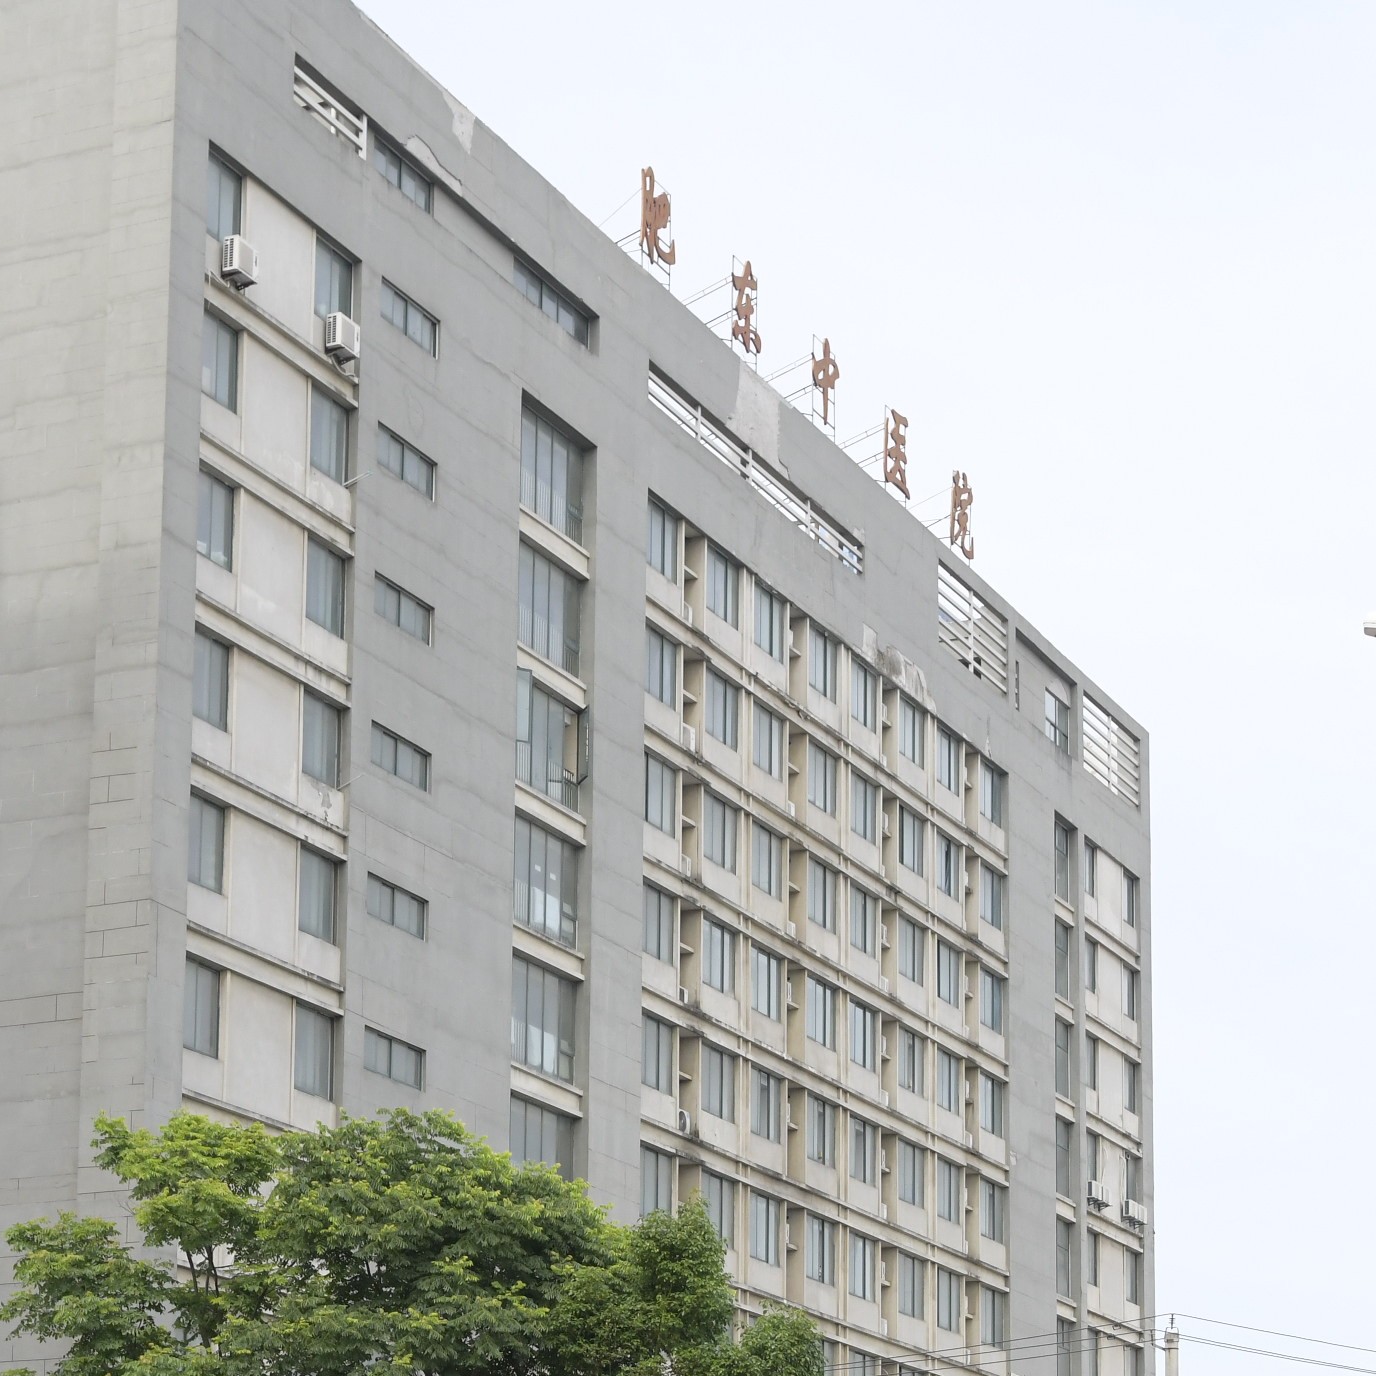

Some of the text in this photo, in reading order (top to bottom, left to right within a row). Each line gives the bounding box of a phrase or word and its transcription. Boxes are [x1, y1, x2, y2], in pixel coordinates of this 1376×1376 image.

[640, 166, 974, 560] 肥东中医院
